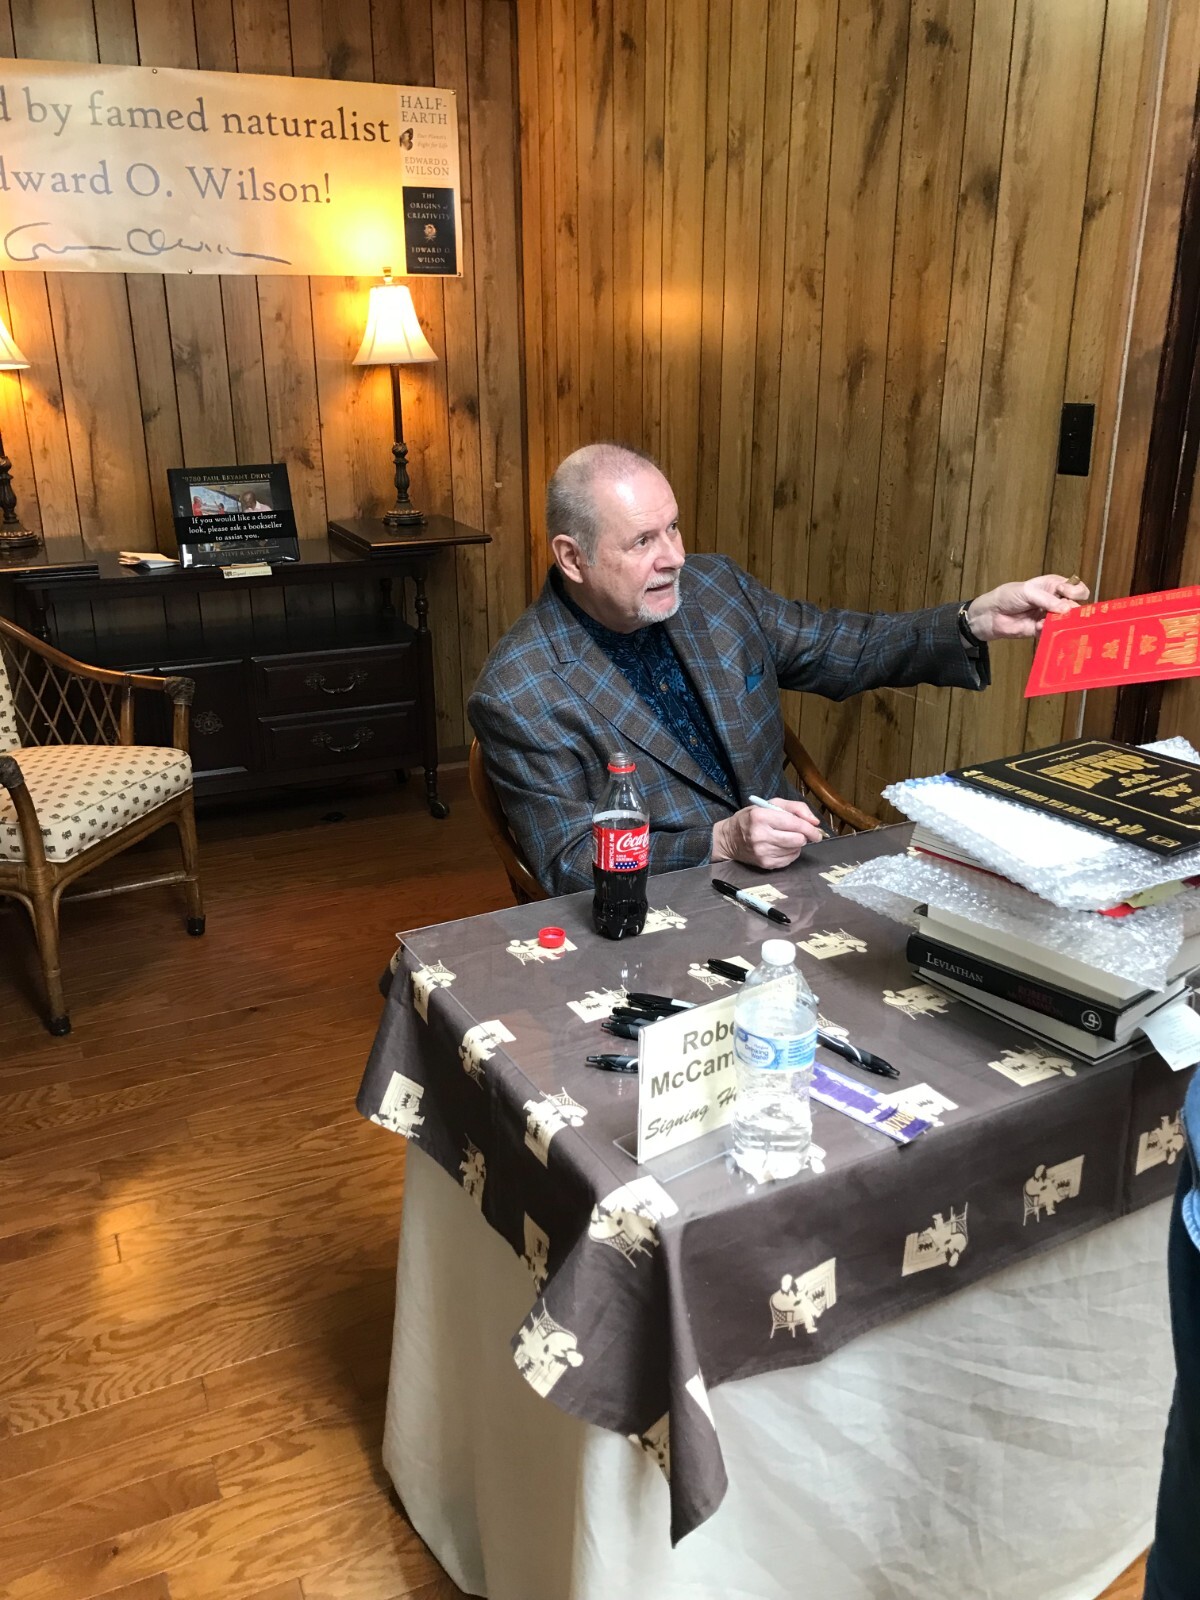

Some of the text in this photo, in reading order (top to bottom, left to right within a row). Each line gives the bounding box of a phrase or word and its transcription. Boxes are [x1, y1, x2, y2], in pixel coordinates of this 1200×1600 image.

[400, 95, 447, 110] HALF-
[22, 86, 72, 137] by
[88, 90, 209, 133] famed
[221, 106, 391, 143] naturalist
[401, 111, 447, 125] EARTH
[404, 156, 440, 166] EDWARD
[405, 165, 450, 176] WILSON
[126, 163, 173, 198] O.
[185, 166, 331, 204] Wilson!
[407, 212, 451, 220] CREATIVITY
[411, 246, 442, 254] EDWARD
[191, 516, 198, 524] If
[215, 515, 236, 523] would
[188, 526, 206, 534] look,
[208, 525, 228, 534] please
[248, 521, 282, 530] bookseller
[1089, 754, 1160, 774] TOP
[609, 832, 615, 843] ME
[926, 952, 984, 984] LEVIATHAN
[745, 1044, 769, 1057] Drinking
[645, 1104, 710, 1141] Signing
